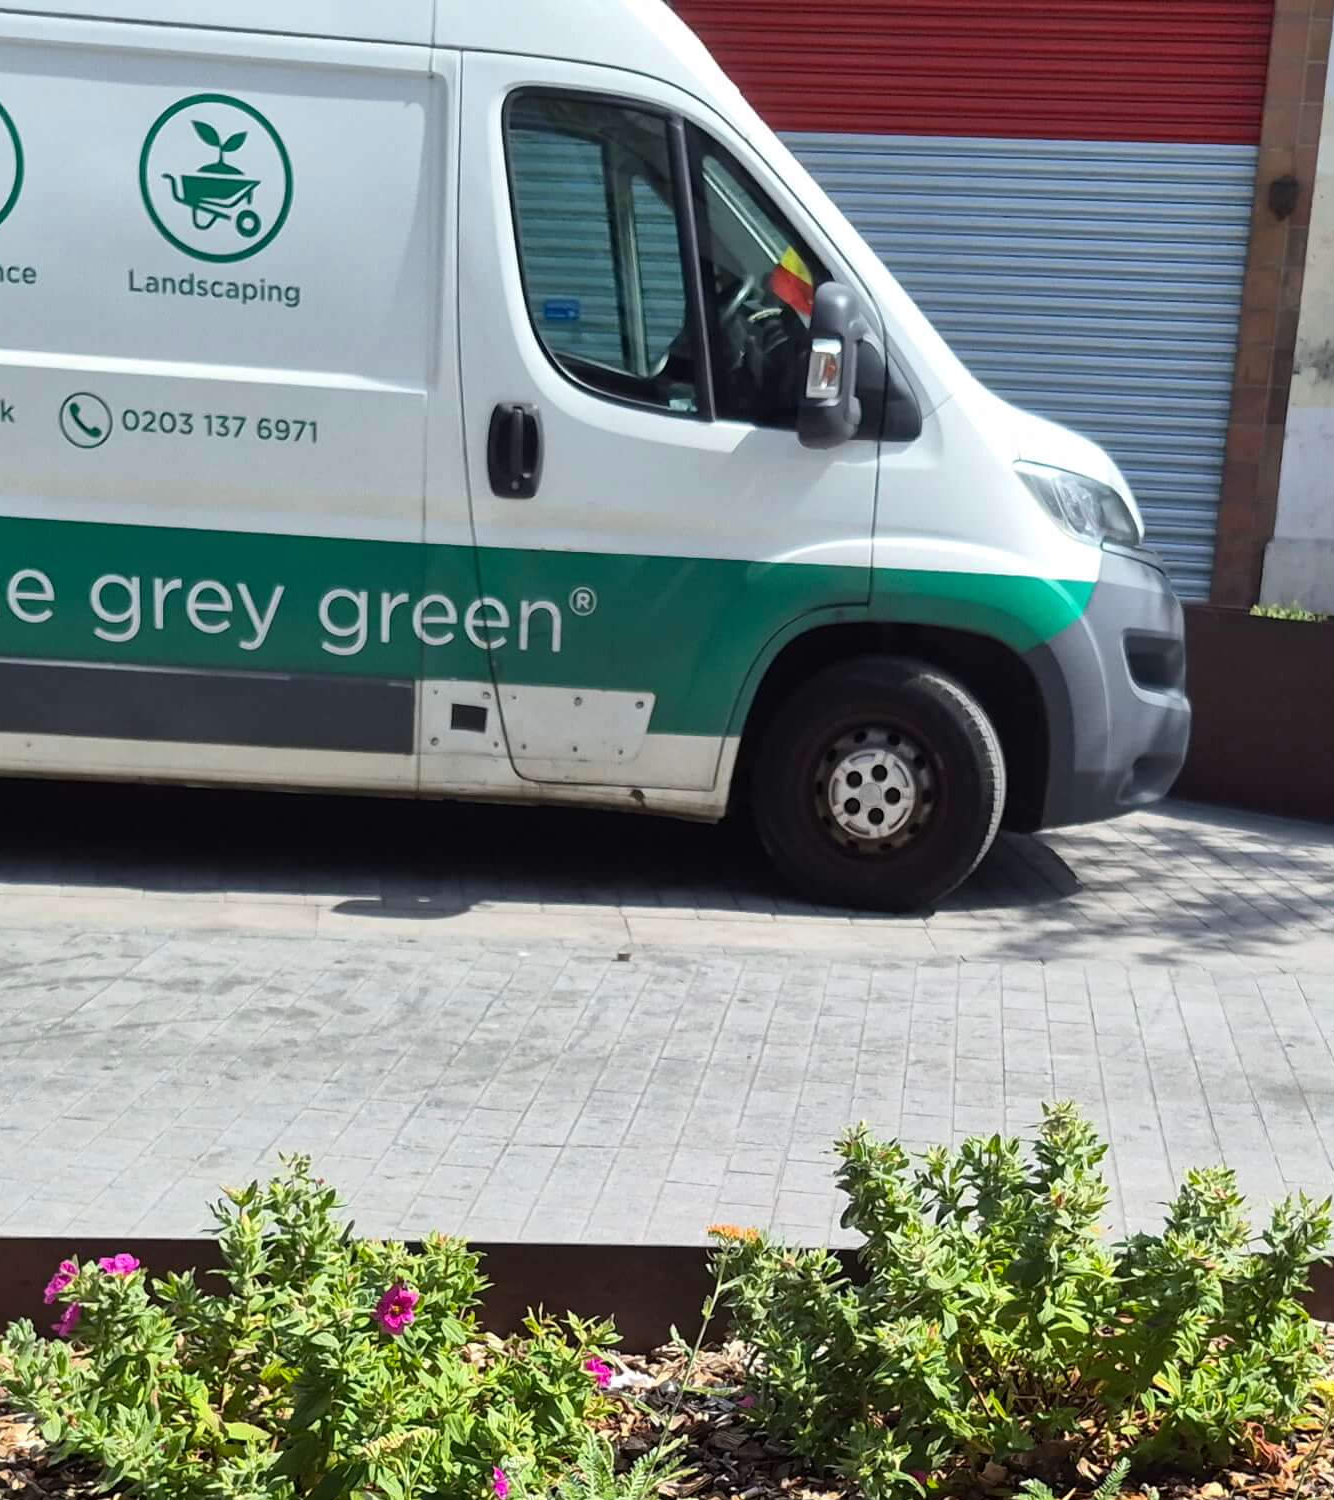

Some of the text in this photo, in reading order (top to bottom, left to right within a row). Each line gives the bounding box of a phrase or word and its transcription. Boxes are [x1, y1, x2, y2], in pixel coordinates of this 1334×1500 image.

[128, 269, 301, 308] Landscaping
[122, 409, 318, 444] 0203 137 6971
[91, 575, 285, 650] grey
